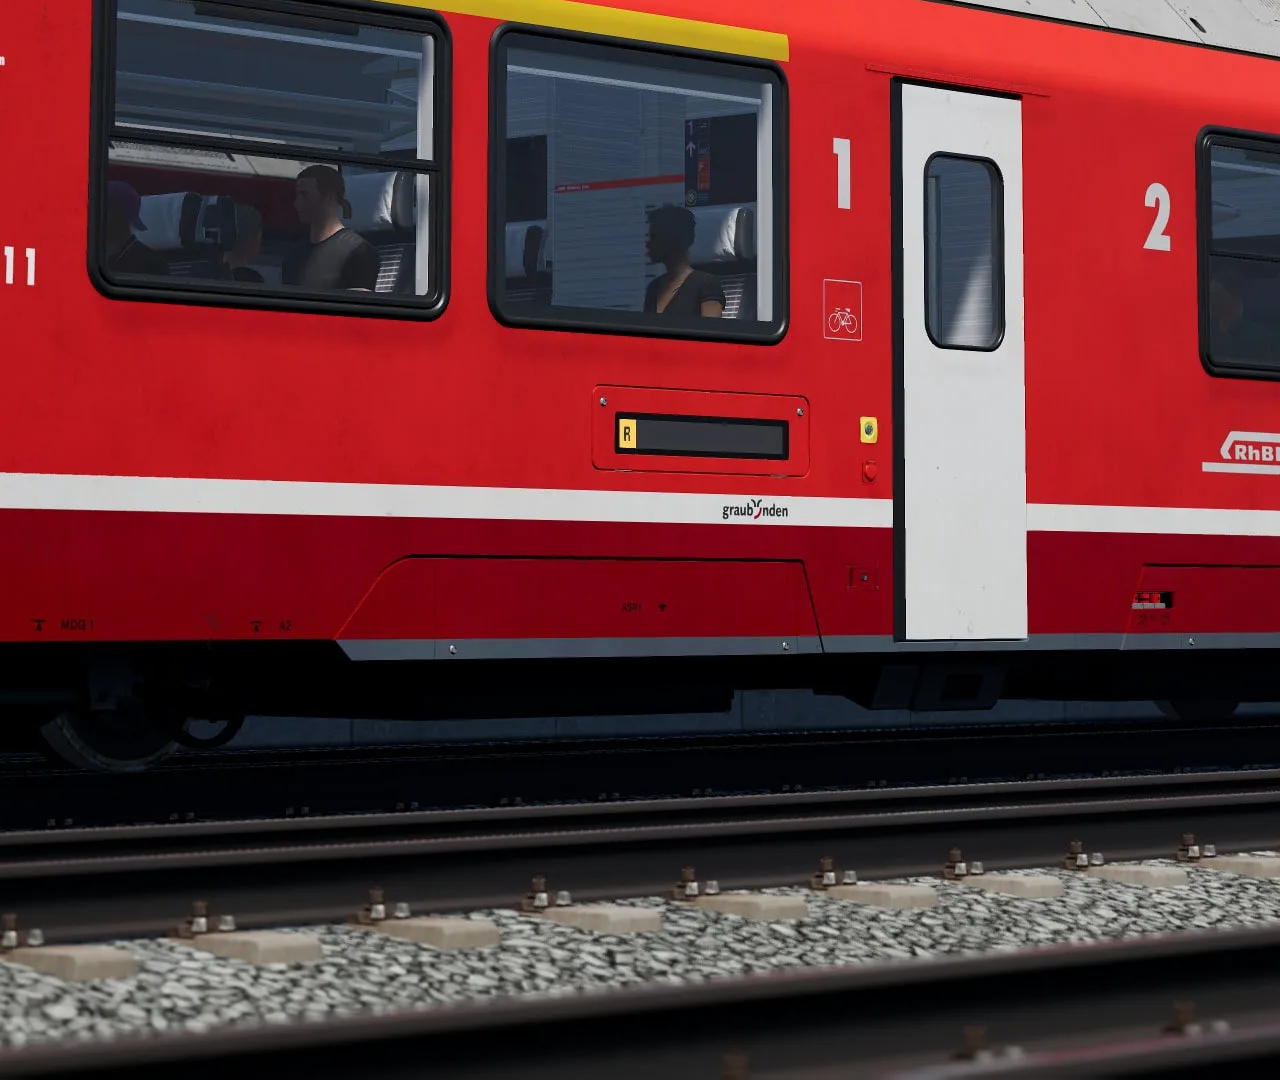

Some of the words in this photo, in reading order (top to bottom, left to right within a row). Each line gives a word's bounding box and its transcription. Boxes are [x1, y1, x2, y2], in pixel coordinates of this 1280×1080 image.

[832, 137, 852, 210] 1
[1142, 182, 1171, 253] 2
[623, 426, 631, 442] R
[1234, 444, 1274, 462] RhB
